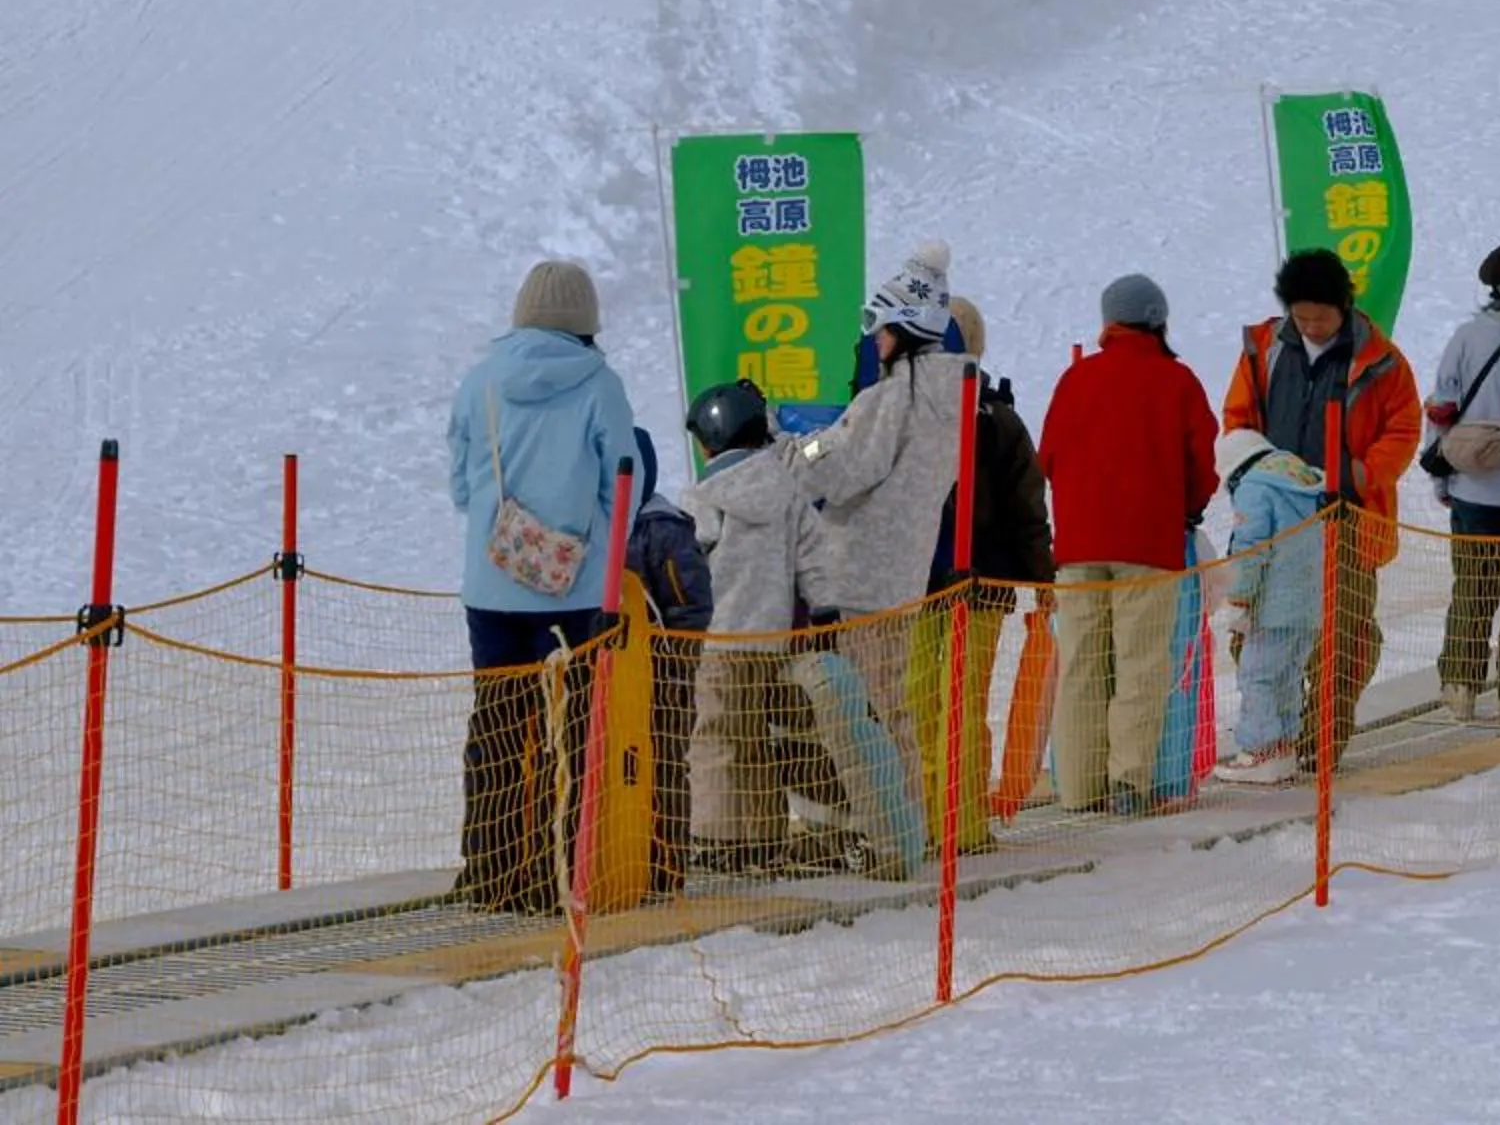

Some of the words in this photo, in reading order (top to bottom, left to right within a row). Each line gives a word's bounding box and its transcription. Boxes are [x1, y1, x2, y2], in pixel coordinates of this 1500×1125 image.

[1321, 108, 1377, 139] 栂池
[735, 154, 808, 192] 栂池
[1328, 142, 1384, 176] 高原
[737, 196, 811, 235] 高原
[1323, 178, 1390, 296] 鐘の
[730, 242, 820, 401] 鐘の鳴
